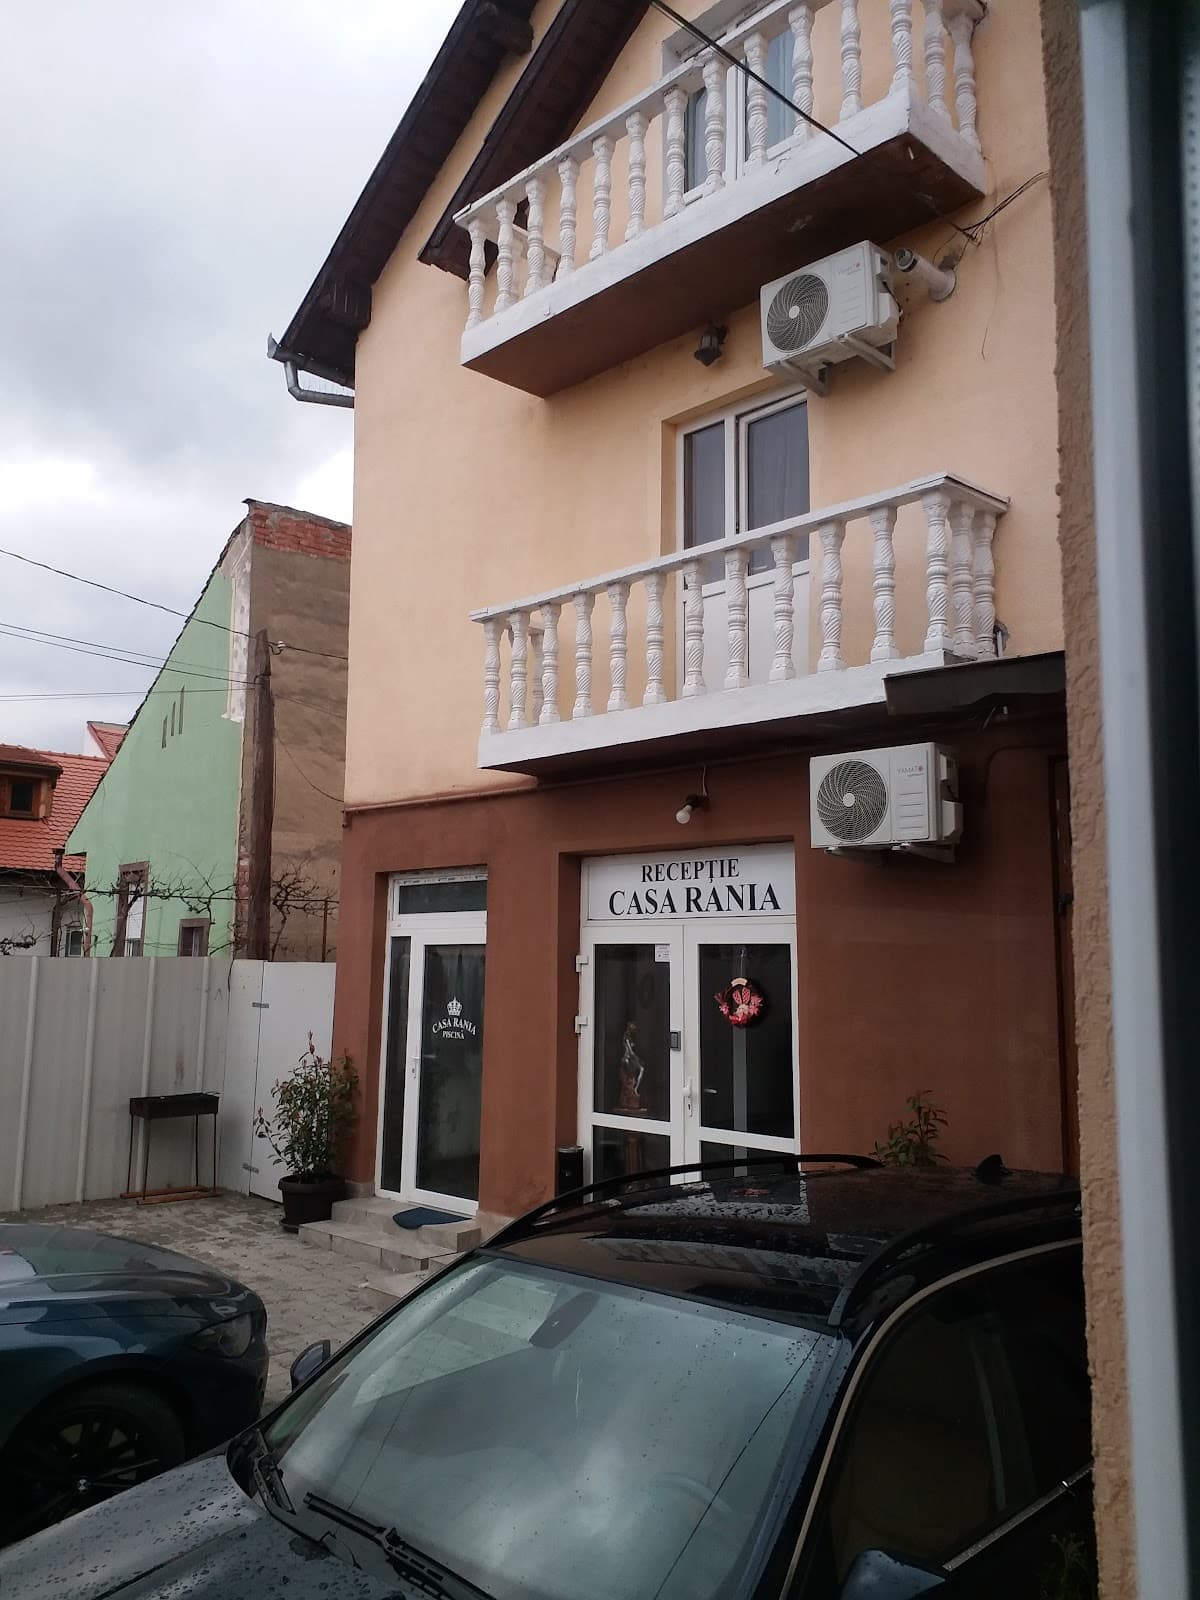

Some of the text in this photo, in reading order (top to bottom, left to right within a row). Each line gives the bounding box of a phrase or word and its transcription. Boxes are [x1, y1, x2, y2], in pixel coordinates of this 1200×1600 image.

[609, 883, 782, 916] CASA RANIA
[432, 1017, 476, 1036] CASA RANIA
